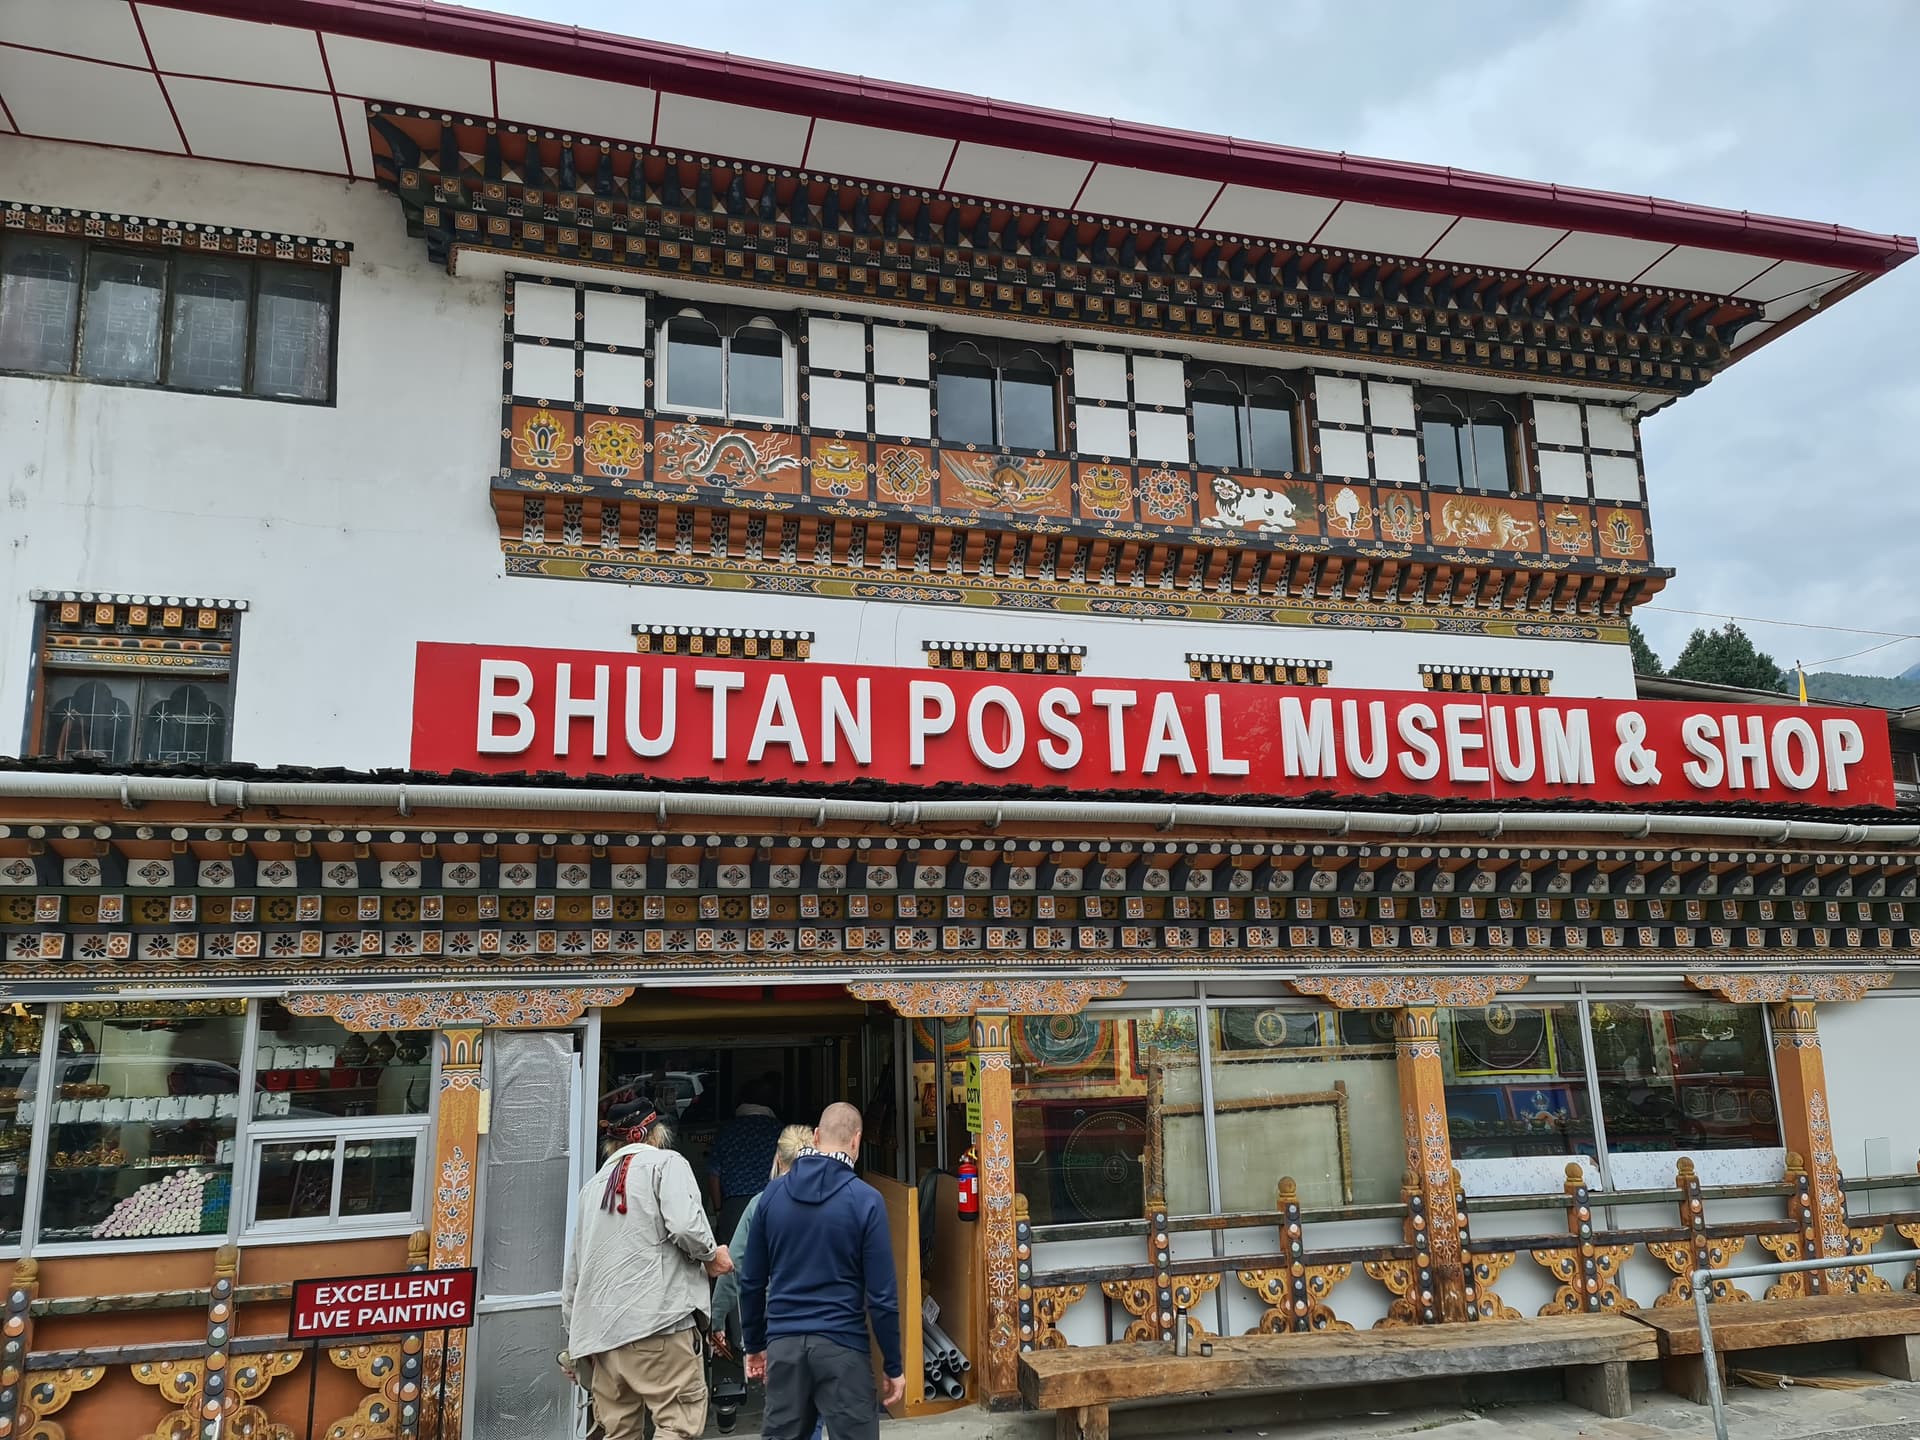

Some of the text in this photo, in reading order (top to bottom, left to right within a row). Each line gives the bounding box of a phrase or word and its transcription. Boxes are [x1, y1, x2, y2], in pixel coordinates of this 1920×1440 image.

[476, 659, 1865, 792] BHUTAN POSTAL MUSEUM & SHOP
[315, 1278, 455, 1305] EXCELLENT
[298, 1301, 466, 1330] LIVE PAINTING
